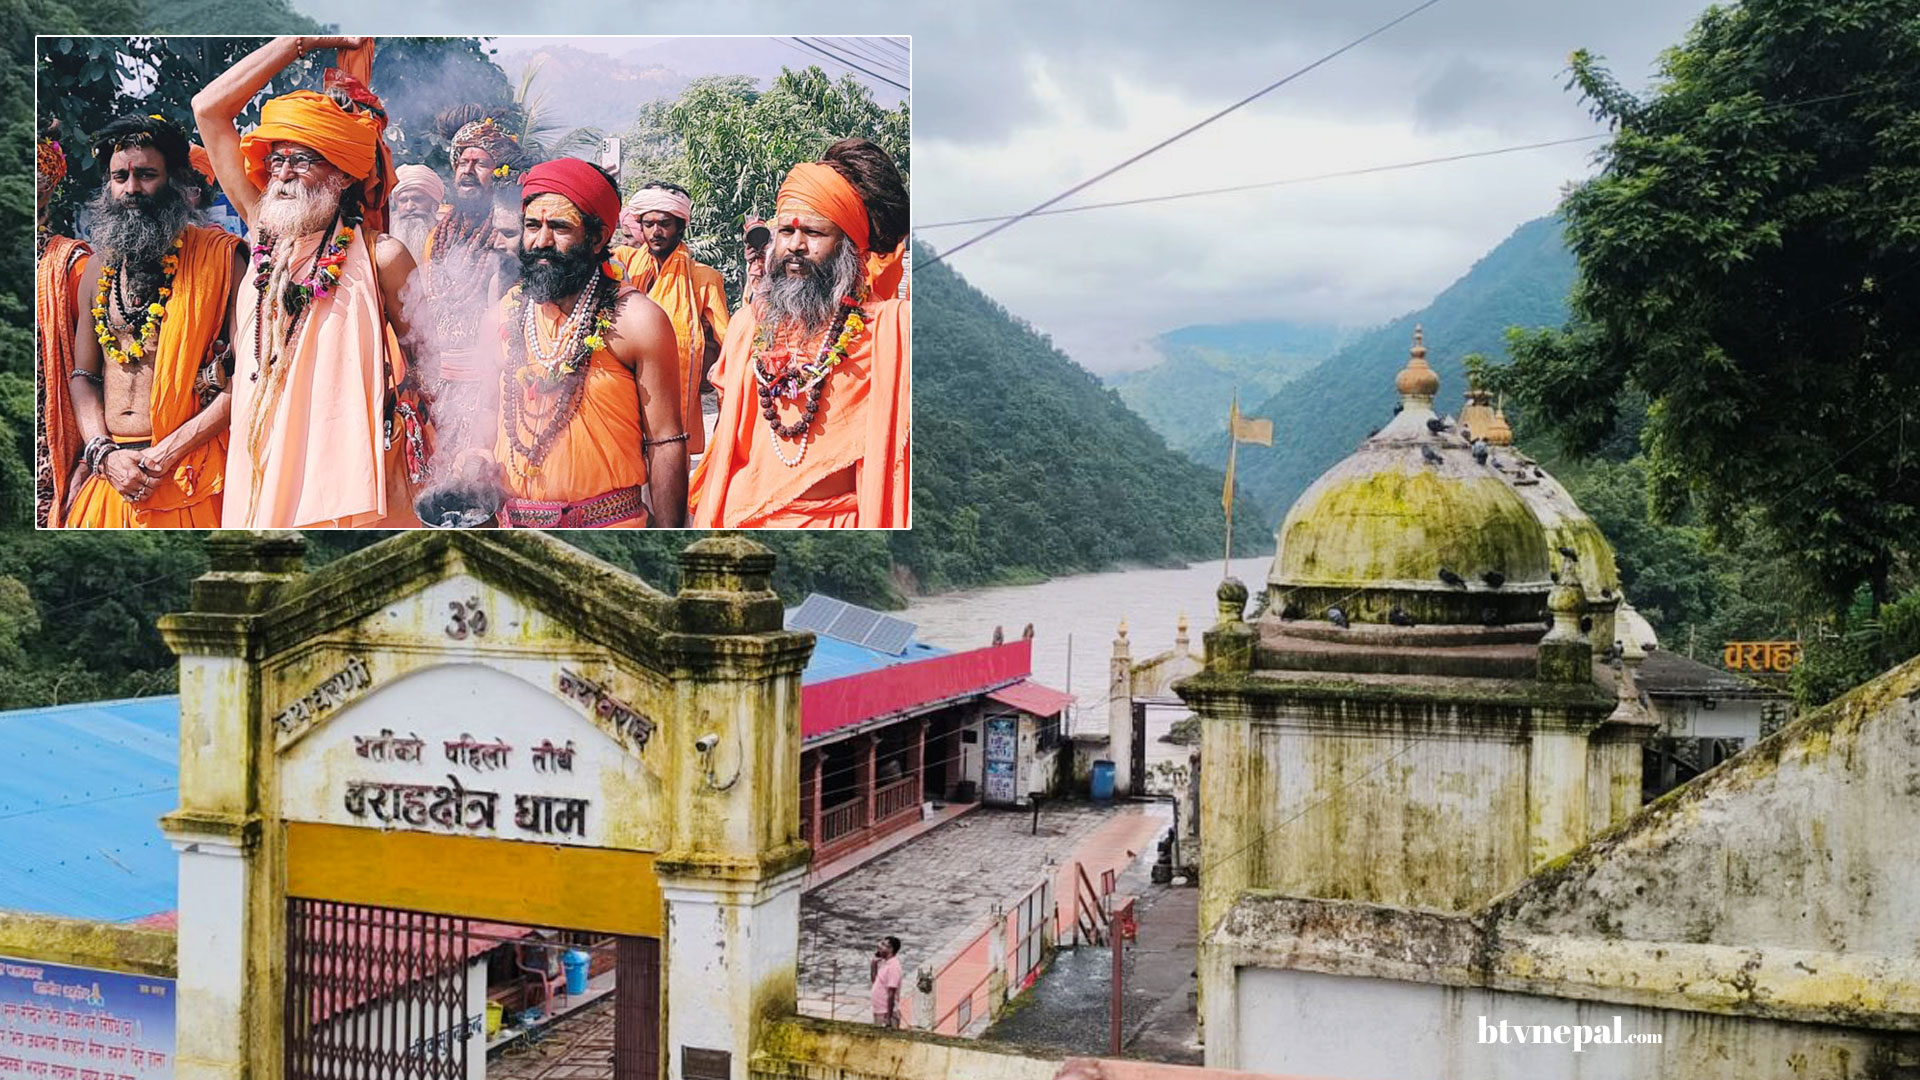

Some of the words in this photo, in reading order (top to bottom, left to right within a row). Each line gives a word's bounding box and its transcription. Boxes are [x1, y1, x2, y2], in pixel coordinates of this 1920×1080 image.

[443, 732, 514, 774] पहिलो
[531, 737, 576, 774] तीर्थ
[345, 773, 499, 831] वराहक्षेत्र
[514, 793, 590, 837] धाम
